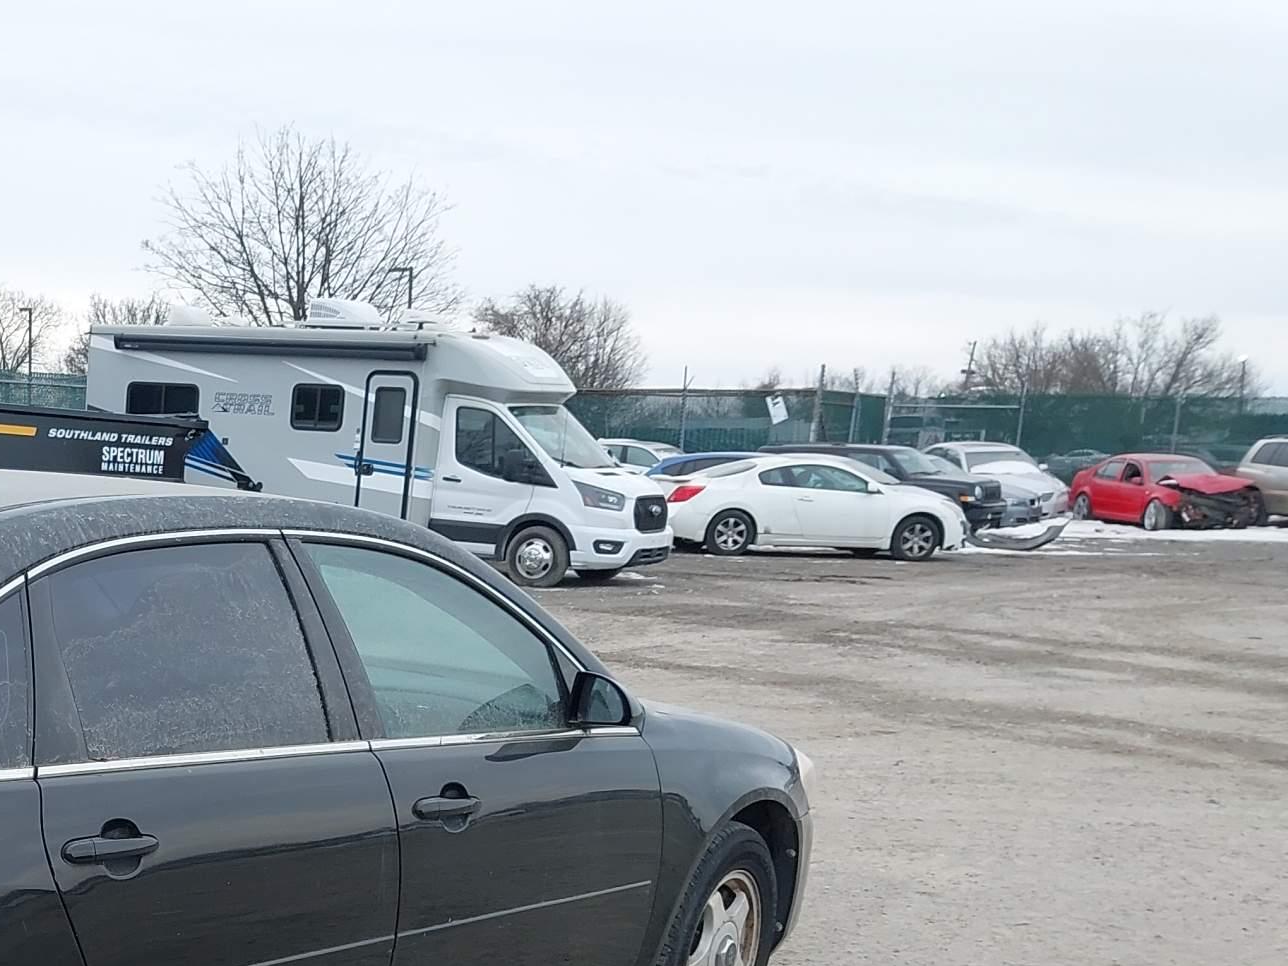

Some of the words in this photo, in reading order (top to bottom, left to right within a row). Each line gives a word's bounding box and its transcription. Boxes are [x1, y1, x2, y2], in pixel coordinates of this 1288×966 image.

[215, 392, 272, 405] CROSS
[48, 428, 118, 442] SOUTHLAND
[121, 434, 173, 446] TRAILERS
[102, 446, 165, 465] SPECTRUM
[101, 462, 164, 474] MAINTENANCE
